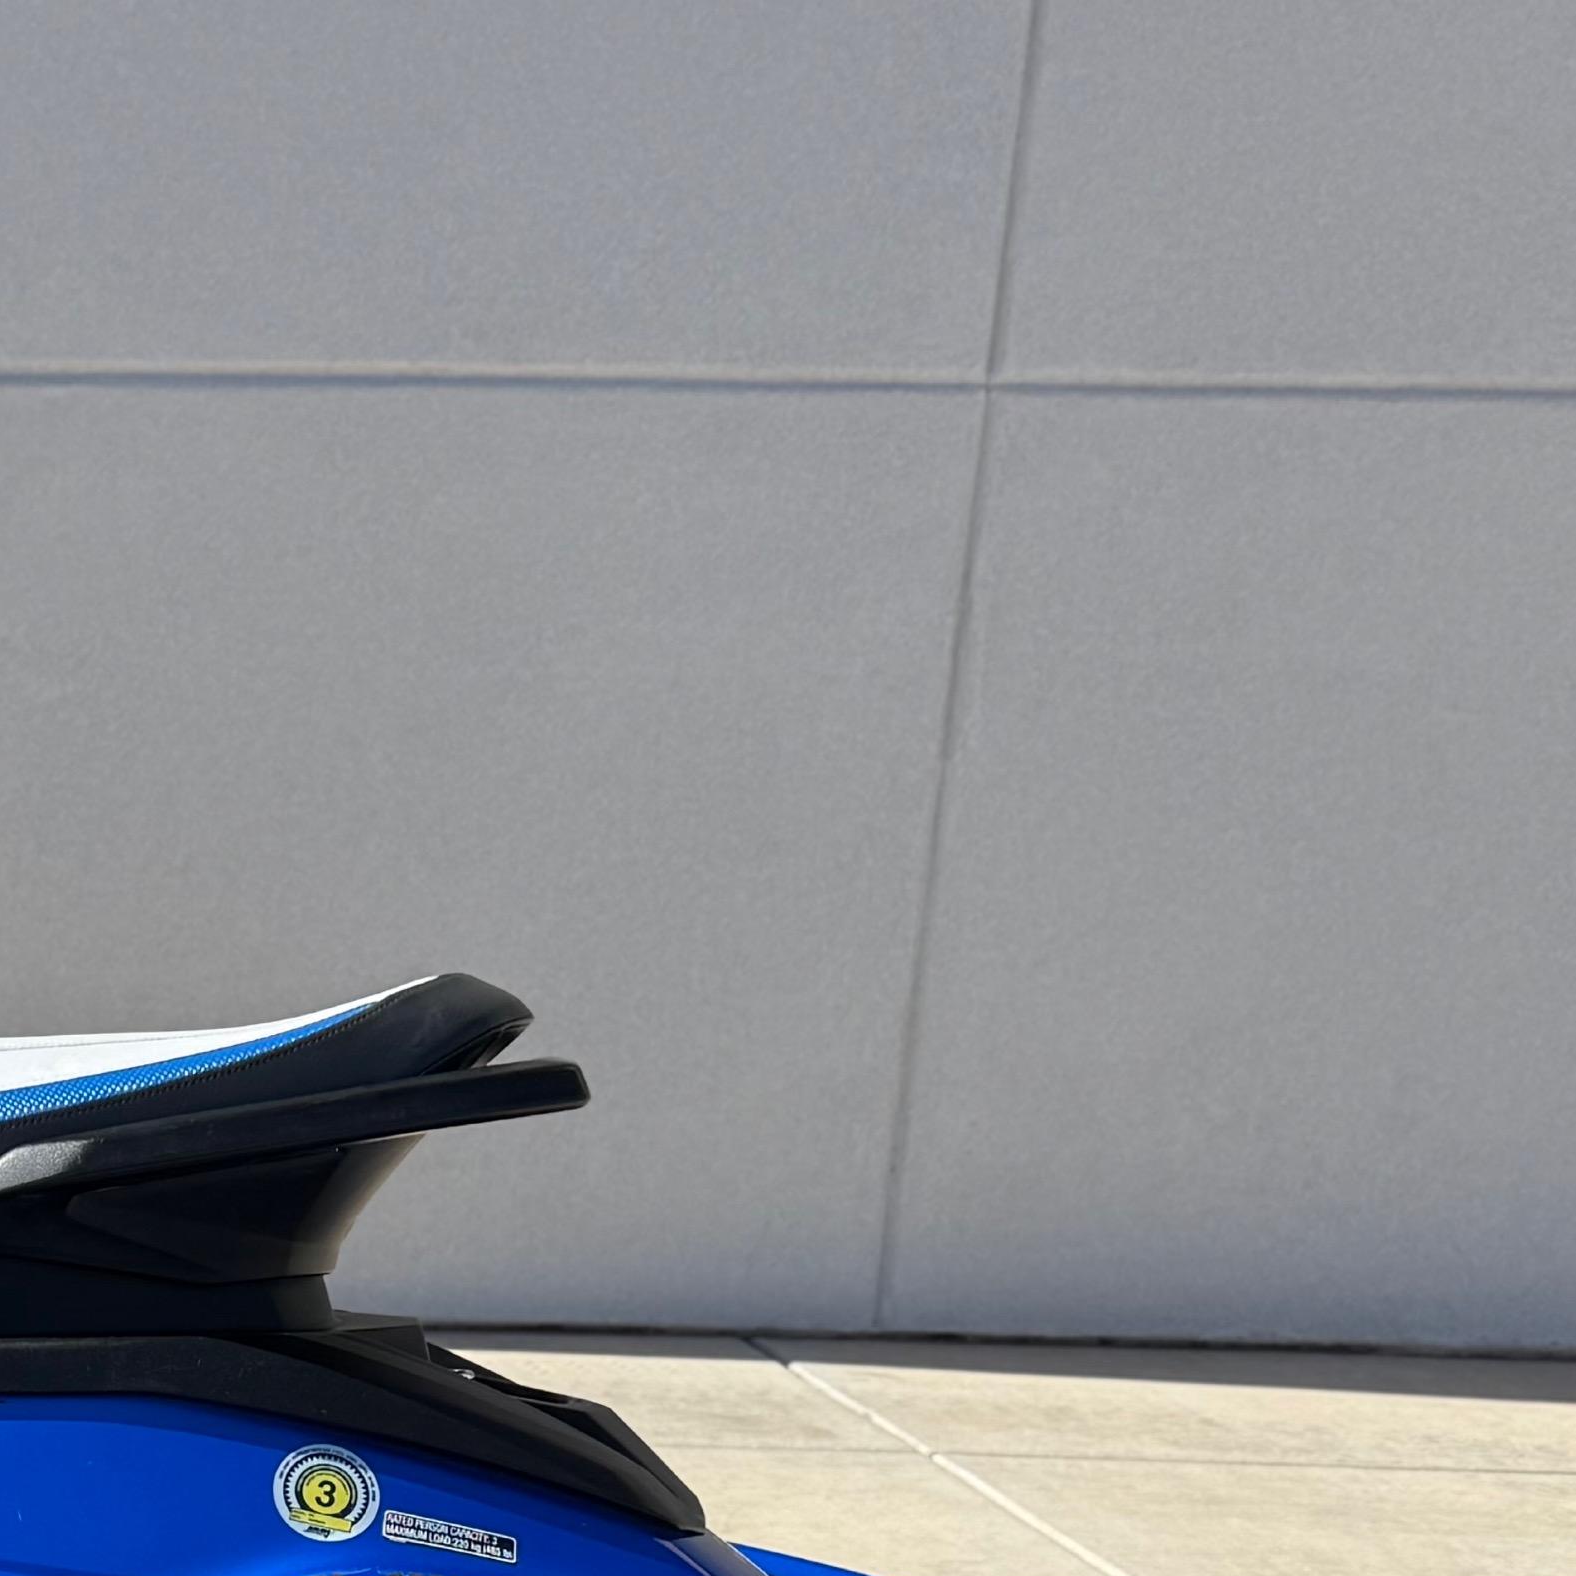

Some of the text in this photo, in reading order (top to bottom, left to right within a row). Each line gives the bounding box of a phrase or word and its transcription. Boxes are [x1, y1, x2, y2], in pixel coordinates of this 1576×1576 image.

[315, 1480, 336, 1508] 3
[386, 1524, 427, 1541] MAXIMUM
[387, 1513, 413, 1527] RATED
[415, 1519, 449, 1534] PERSON
